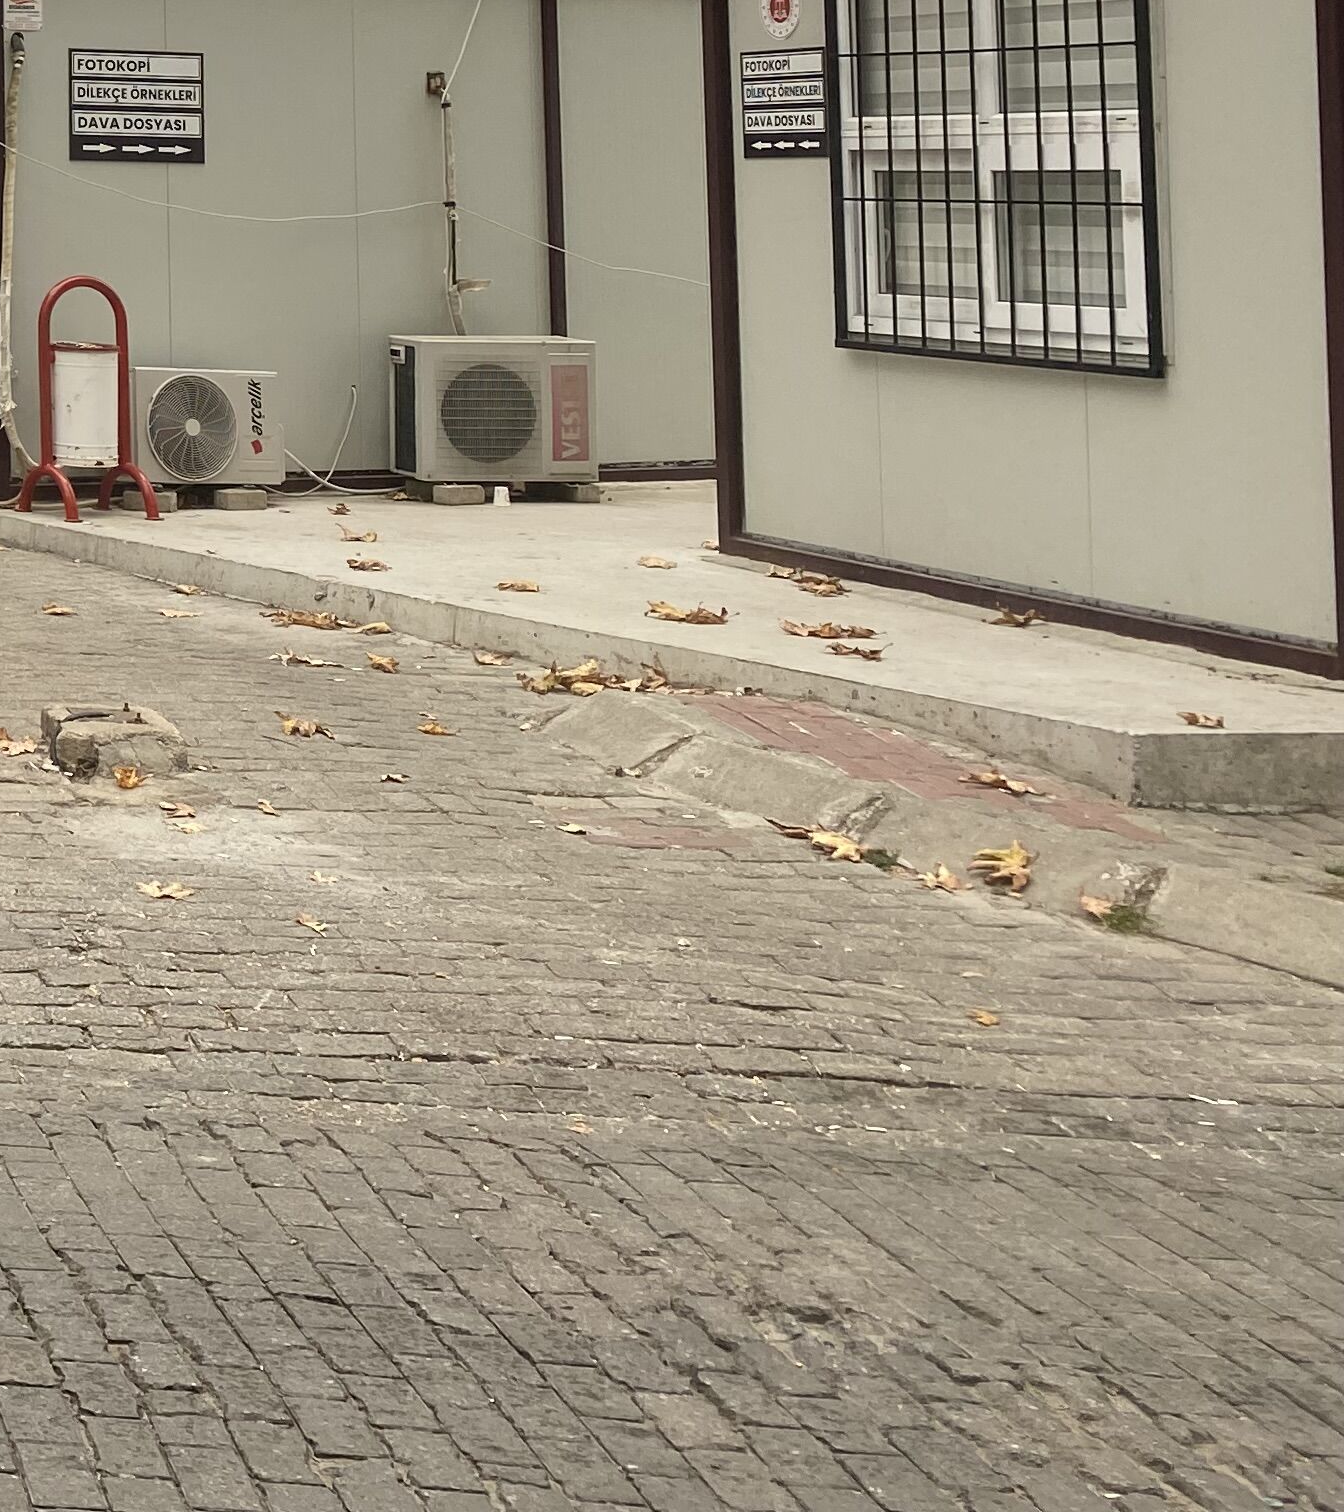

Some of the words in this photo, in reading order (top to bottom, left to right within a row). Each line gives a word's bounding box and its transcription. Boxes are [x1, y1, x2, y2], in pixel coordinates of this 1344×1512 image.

[77, 57, 151, 73] FOTOKOPİ
[745, 55, 790, 72] FOTOKOPİ
[77, 83, 128, 103] DİLEKÇE
[130, 85, 197, 102] ÖRNEKLERİ
[746, 85, 777, 101] DİLEKÇE
[778, 82, 821, 97] ÖRNEKLERİ
[78, 116, 120, 130] DAVA
[123, 117, 187, 131] DOSYASI
[747, 115, 773, 127] DAVA
[774, 113, 816, 126] DOSYASI
